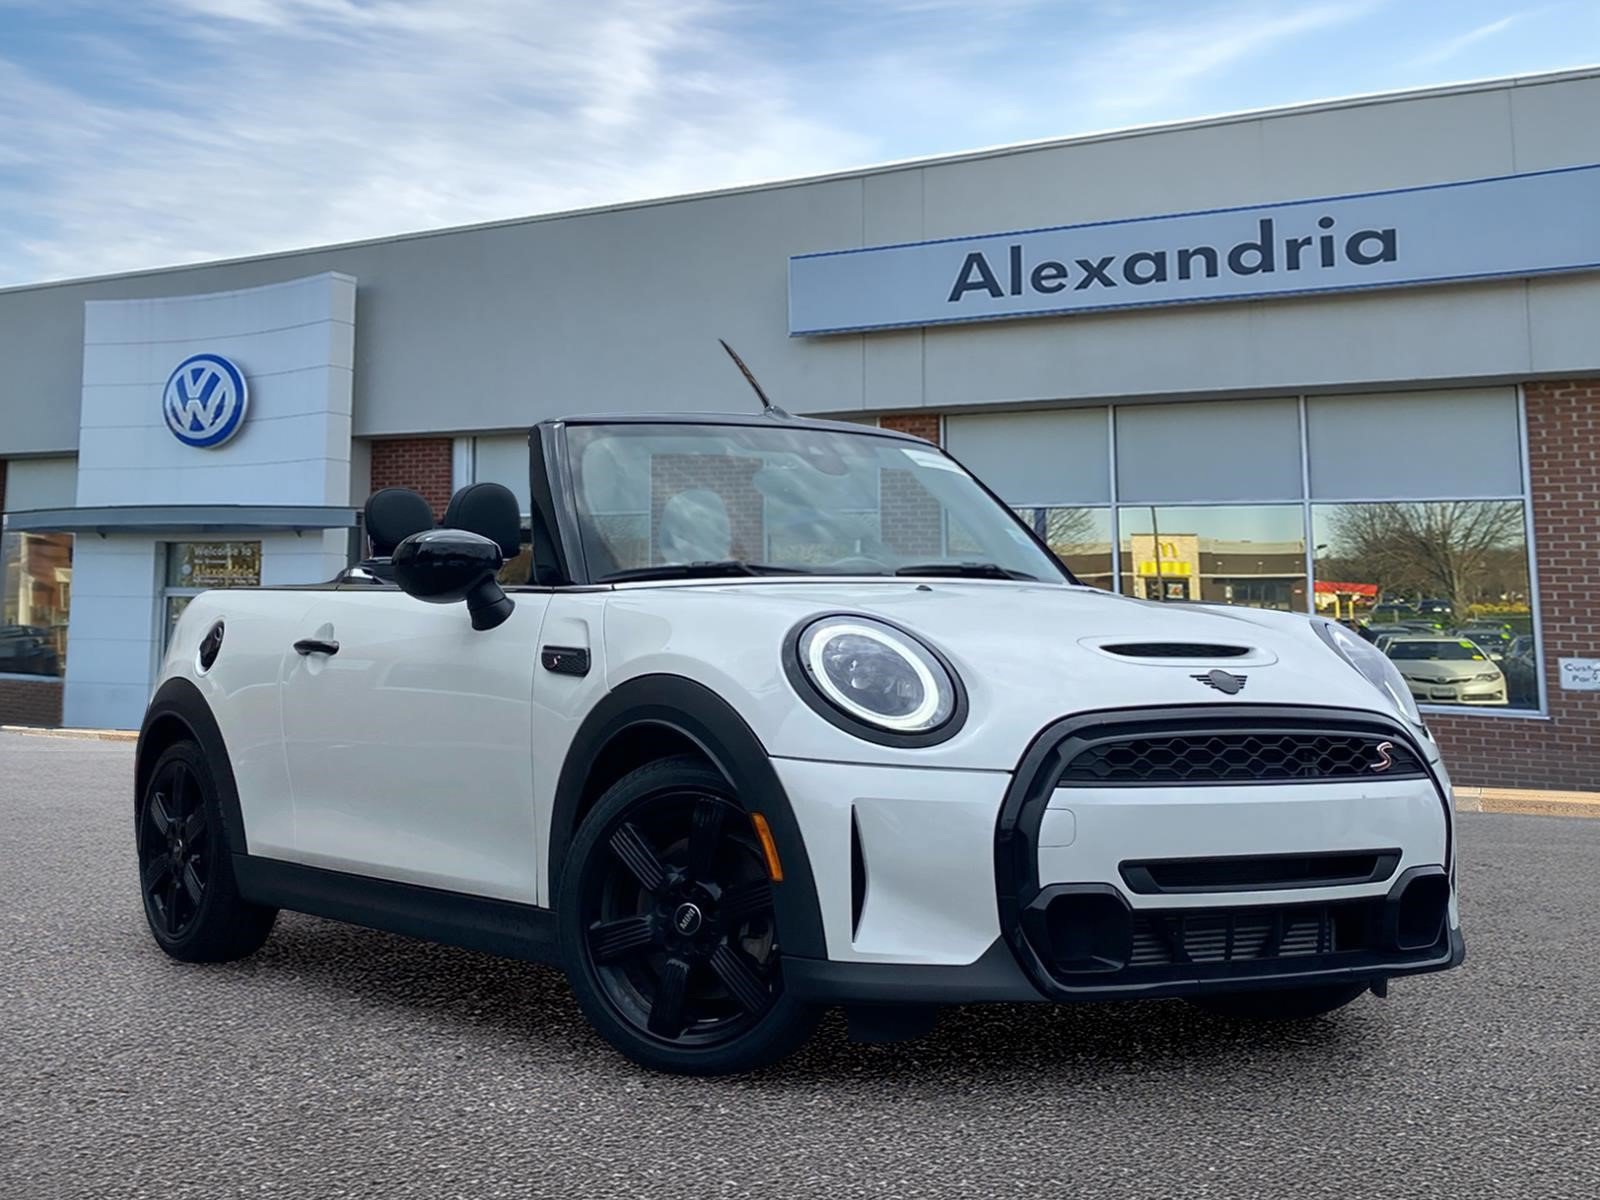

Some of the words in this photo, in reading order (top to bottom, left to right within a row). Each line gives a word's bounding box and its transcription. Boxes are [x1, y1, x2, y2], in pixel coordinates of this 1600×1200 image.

[947, 216, 1398, 303] Alexandria
[165, 357, 240, 442] VW
[1369, 741, 1393, 772] S
